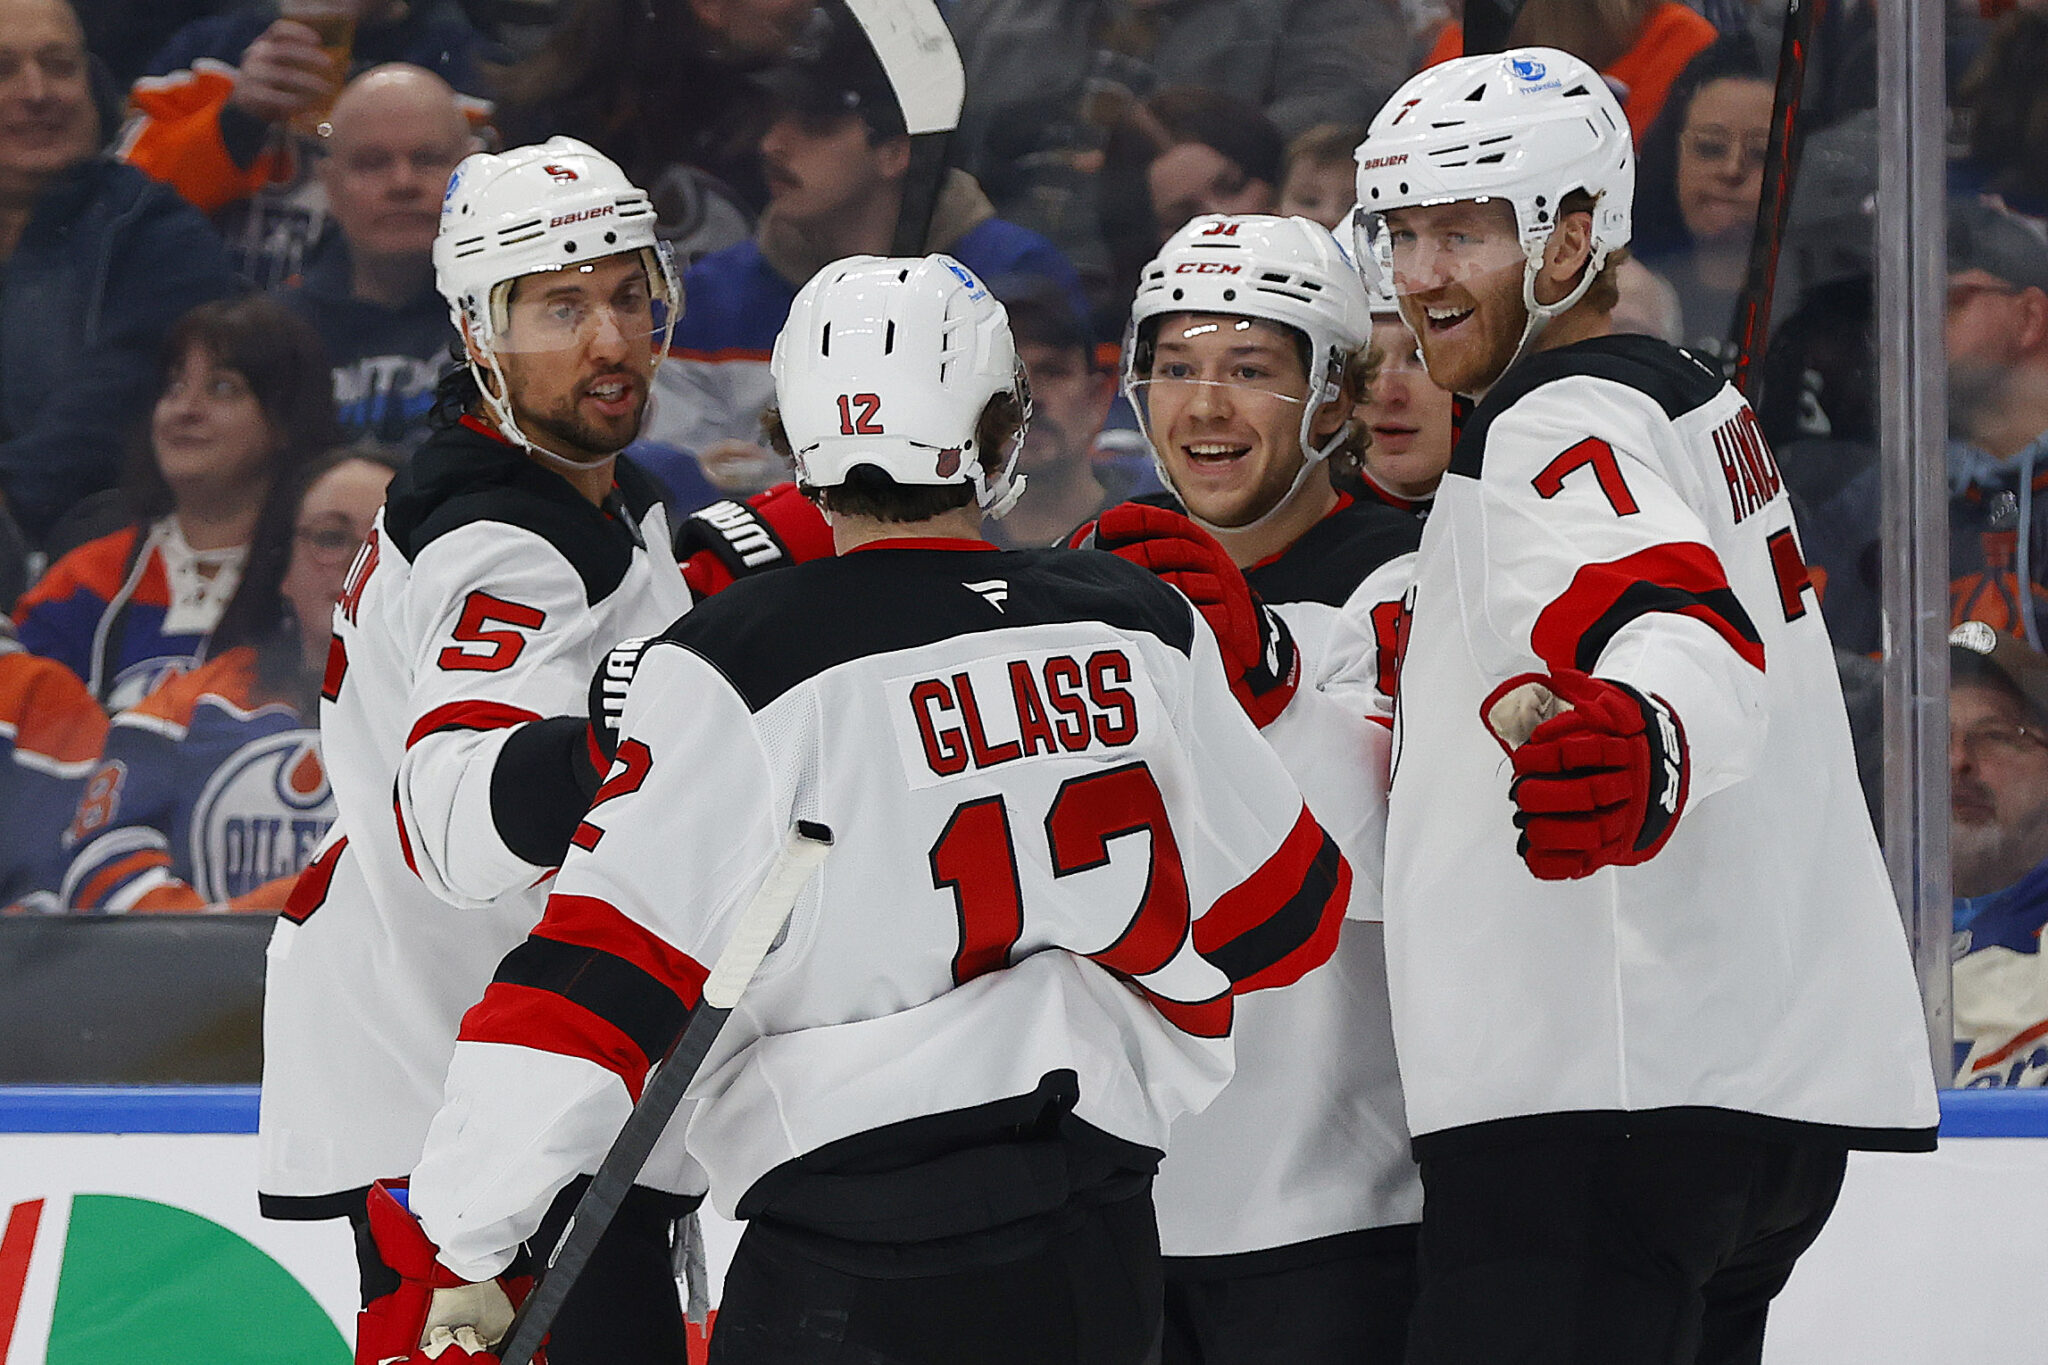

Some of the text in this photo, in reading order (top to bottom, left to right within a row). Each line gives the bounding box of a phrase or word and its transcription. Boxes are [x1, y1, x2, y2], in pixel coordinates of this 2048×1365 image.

[1392, 98, 1422, 126] 7
[543, 164, 579, 185] 5
[1364, 153, 1409, 170] BAUER
[550, 204, 615, 228] BAUER
[1175, 261, 1242, 275] CCM
[836, 392, 885, 436] 12
[1532, 435, 1640, 518] 7
[438, 590, 547, 672] 5
[909, 648, 1140, 778] GLASS
[927, 759, 1236, 1039] 12
